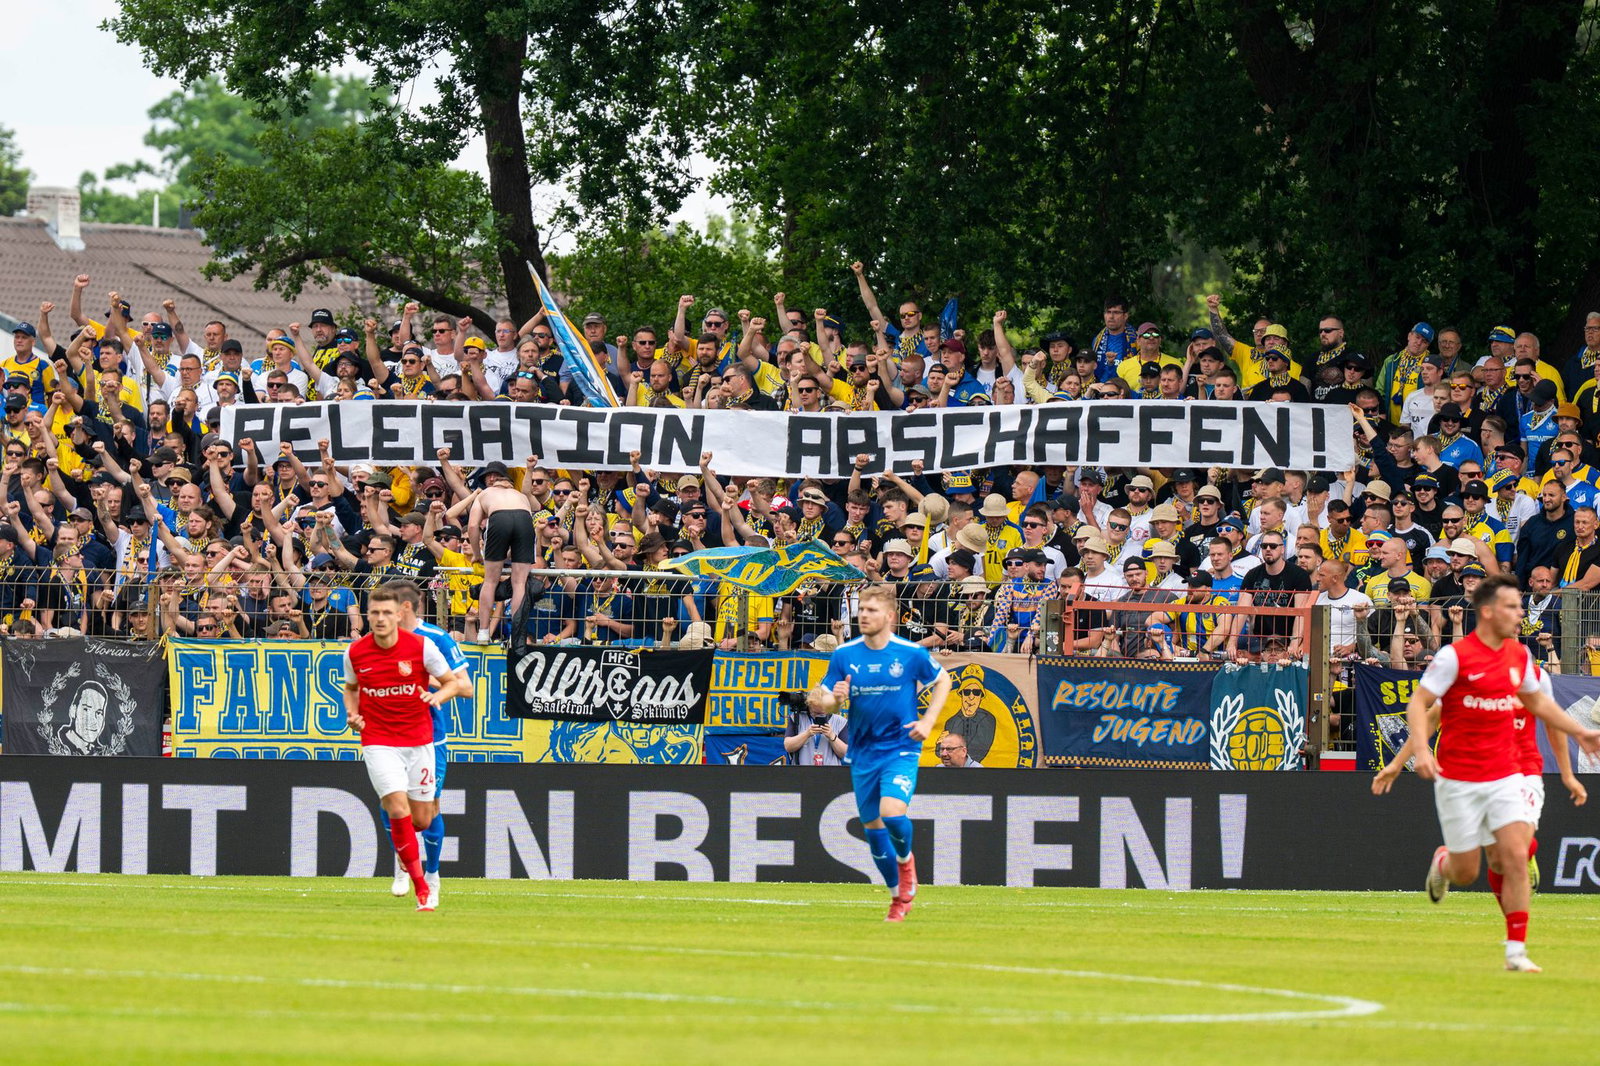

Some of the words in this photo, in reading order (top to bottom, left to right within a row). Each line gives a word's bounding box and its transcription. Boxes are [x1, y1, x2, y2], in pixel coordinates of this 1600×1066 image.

[232, 404, 705, 466] RELEGATION
[786, 405, 1326, 476] ABSCHAFFEN!
[85, 640, 131, 656] Florian
[608, 652, 634, 665] HFC
[712, 659, 782, 689] TIFOSI
[786, 660, 810, 689] IN
[175, 648, 523, 739] FANSNE
[532, 697, 595, 716] Saalefront
[1051, 678, 1183, 713] RESOLUTE
[1091, 714, 1207, 748] JUGEND
[0, 781, 247, 876] MIT
[291, 787, 575, 881] DN
